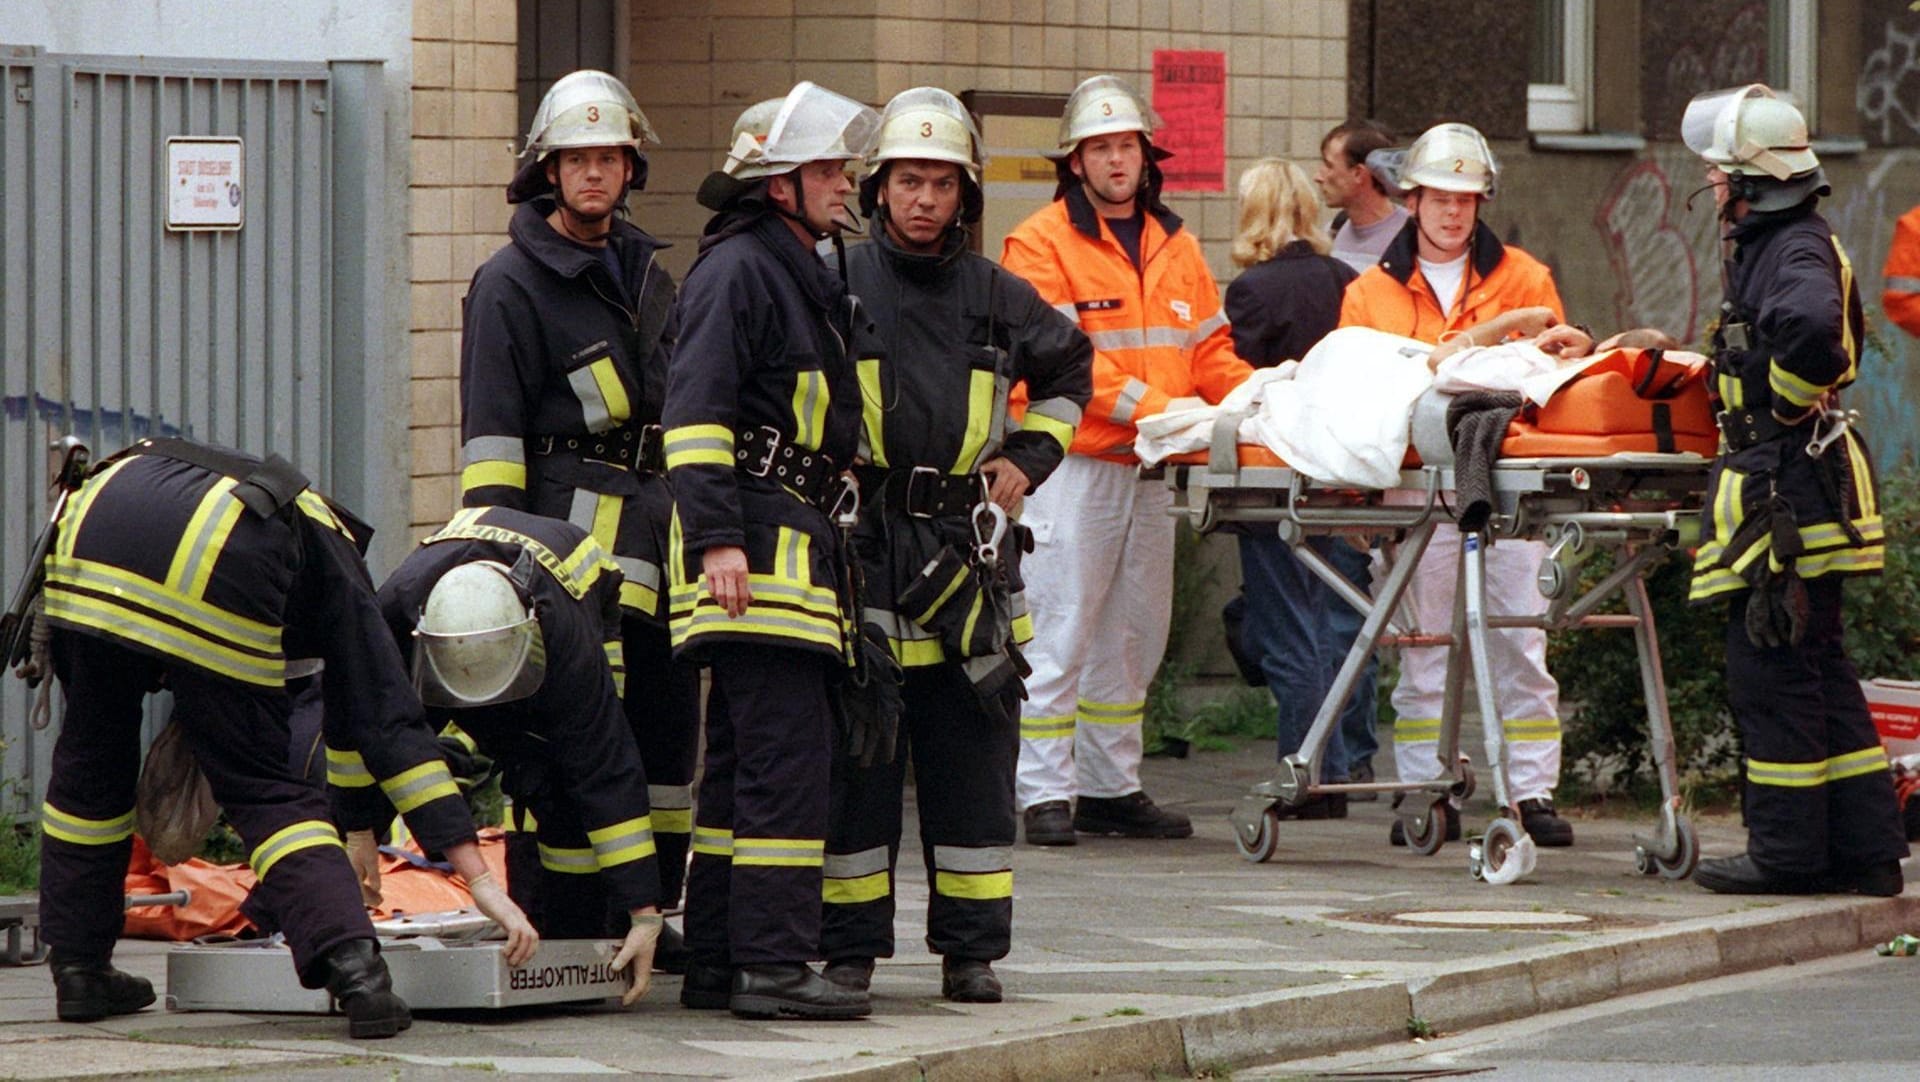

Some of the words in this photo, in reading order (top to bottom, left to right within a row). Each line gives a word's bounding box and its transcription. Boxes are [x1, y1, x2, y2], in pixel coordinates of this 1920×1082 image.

[587, 105, 601, 123] 3
[1102, 102, 1113, 116] 3
[920, 121, 933, 138] 3
[1453, 159, 1465, 174] 2
